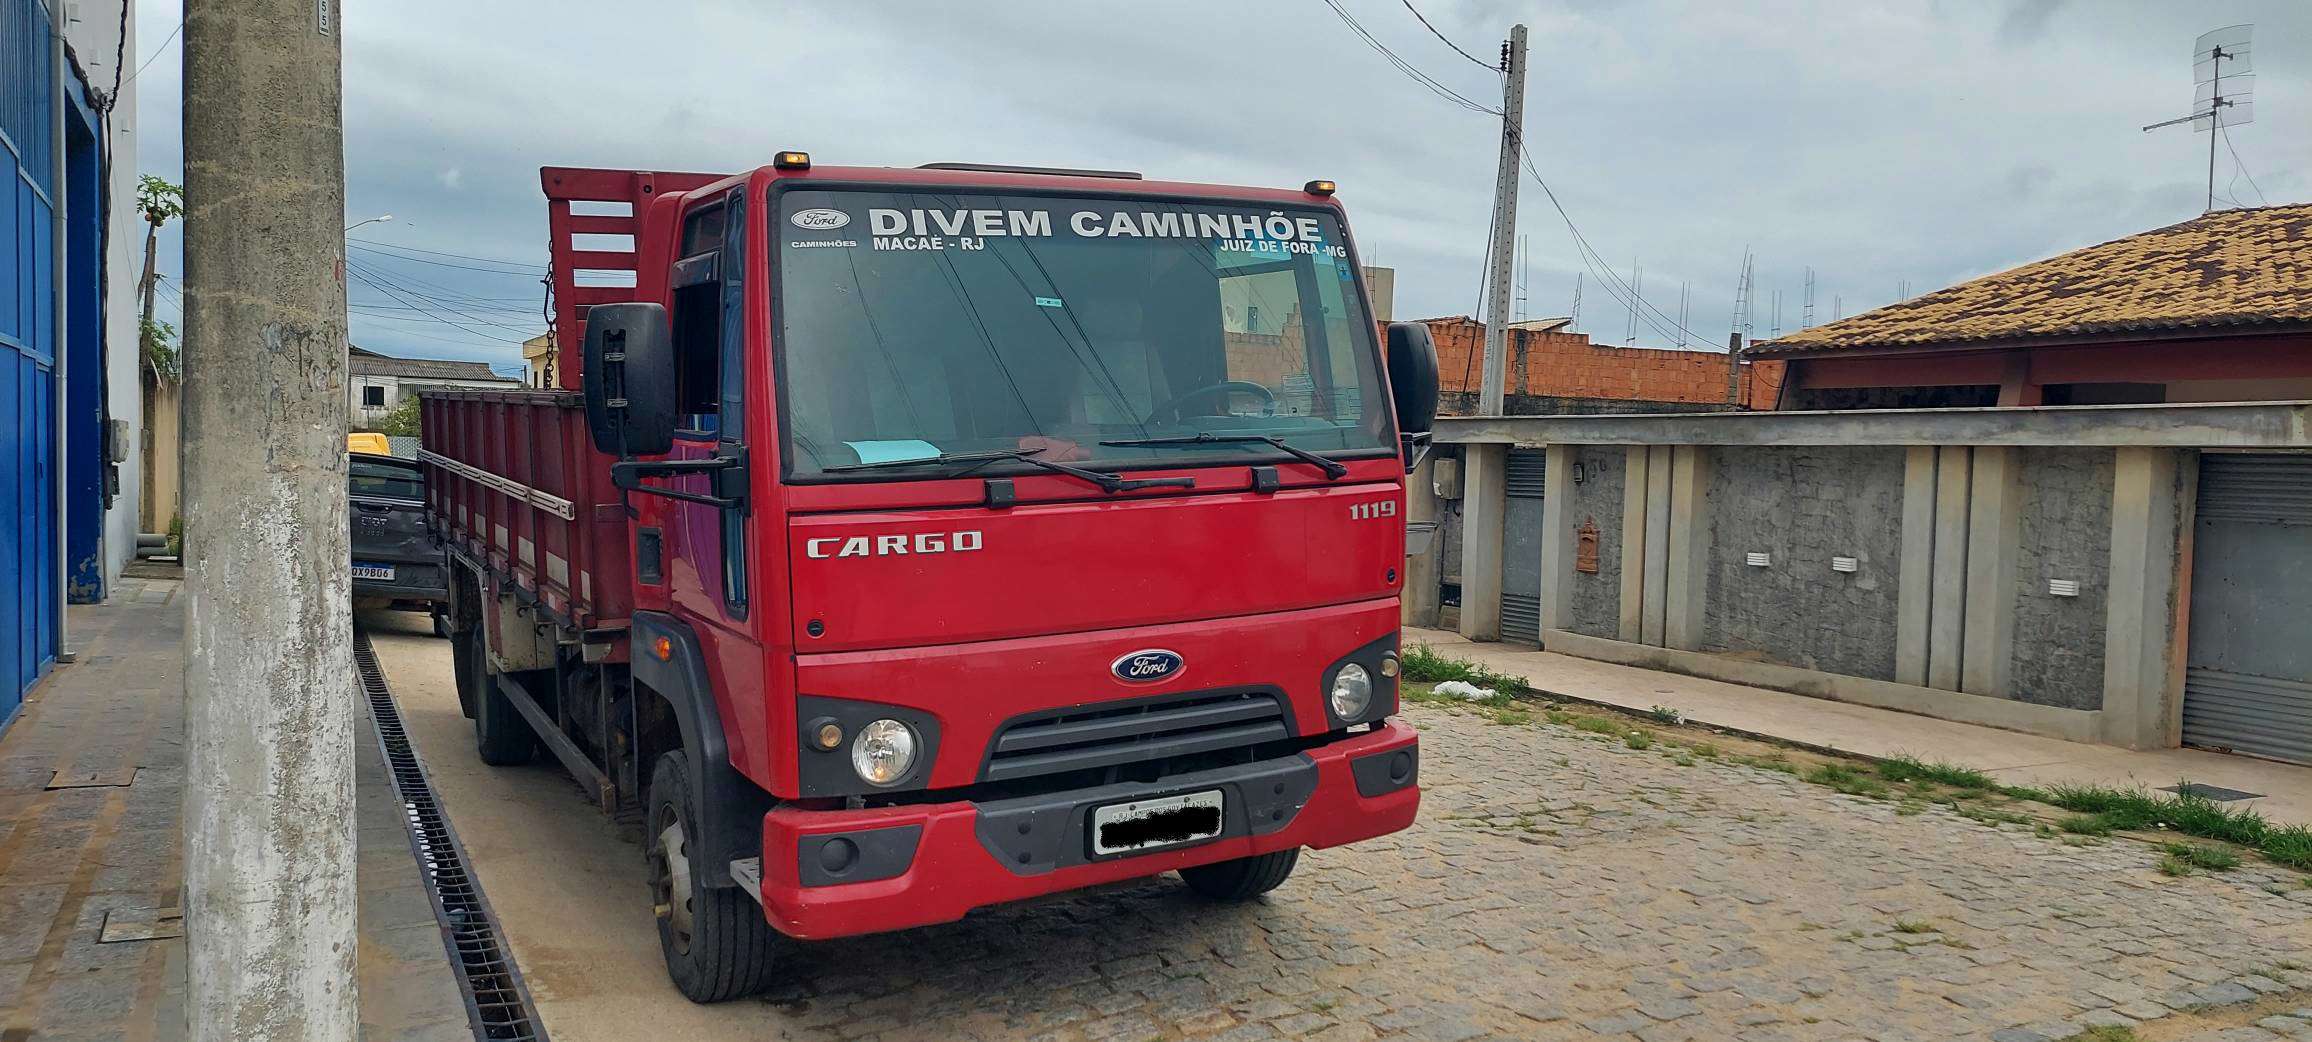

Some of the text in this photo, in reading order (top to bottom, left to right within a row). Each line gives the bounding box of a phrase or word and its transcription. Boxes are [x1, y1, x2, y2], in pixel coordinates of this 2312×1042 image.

[802, 212, 838, 226] Ford
[868, 208, 1322, 242] DIVEM CAMINHÕE
[791, 239, 857, 249] CAMINHÕES
[961, 237, 985, 251] RJ
[1220, 239, 1255, 252] JUIZ
[1258, 240, 1278, 253] DE
[1282, 241, 1319, 255] FORA
[1349, 500, 1396, 520] 1119
[807, 530, 982, 559] CARGO
[1130, 655, 1169, 676] Ford
